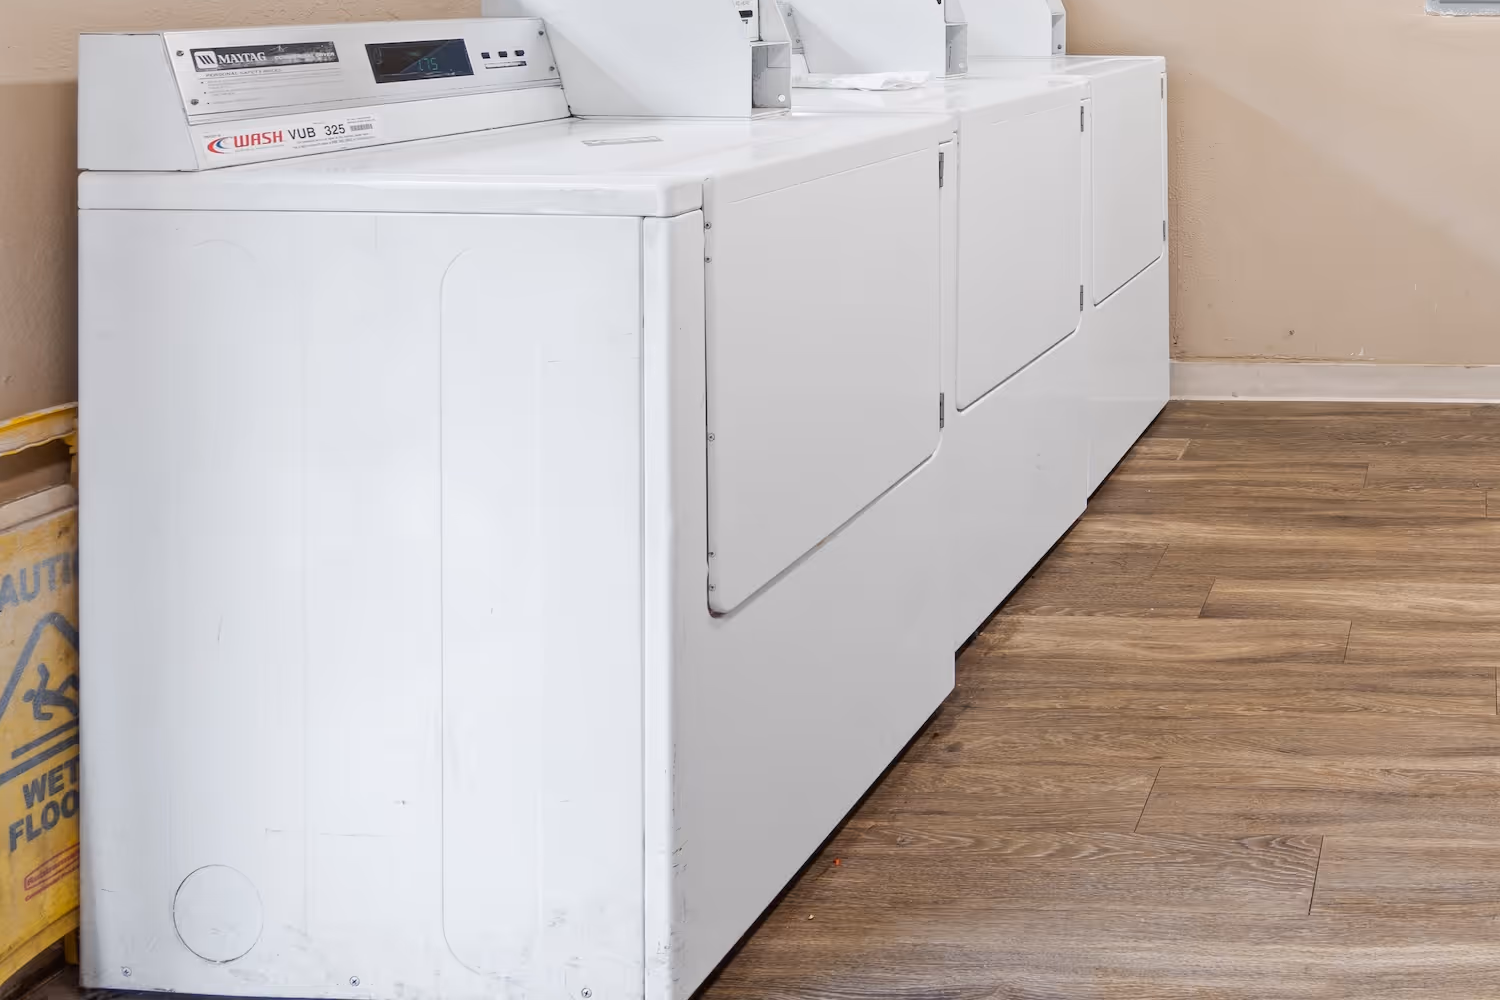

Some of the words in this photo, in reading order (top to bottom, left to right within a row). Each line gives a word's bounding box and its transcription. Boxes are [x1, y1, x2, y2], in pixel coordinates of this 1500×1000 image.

[217, 52, 267, 65] MAYTAG
[233, 130, 283, 148] WASH
[288, 127, 316, 140] VUB
[324, 124, 346, 136] 325
[0, 552, 71, 610] AUTI
[22, 757, 79, 809] WET
[9, 789, 79, 853] FLOO
